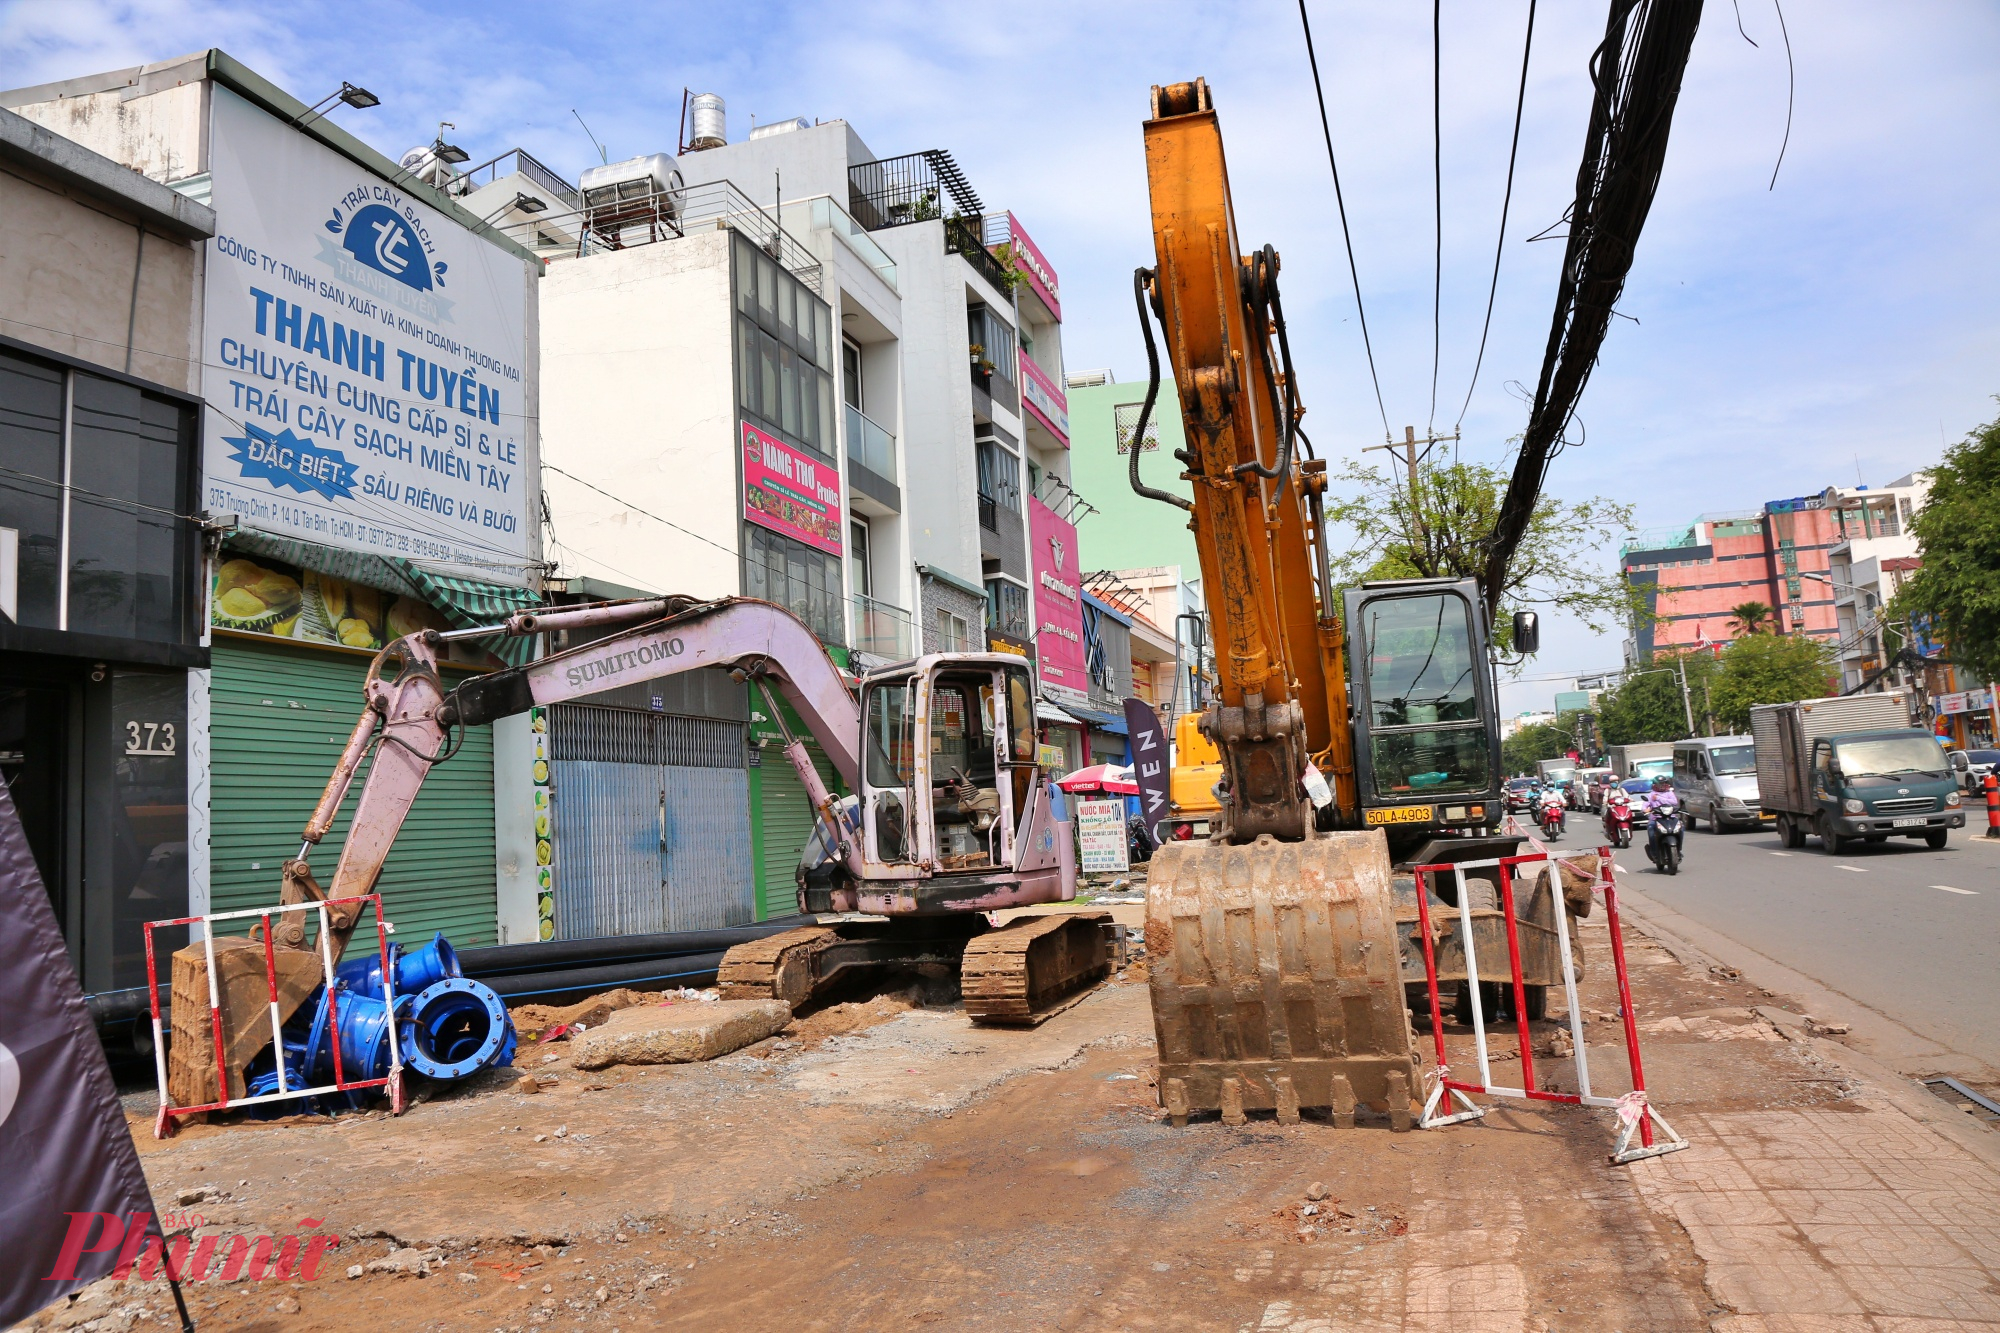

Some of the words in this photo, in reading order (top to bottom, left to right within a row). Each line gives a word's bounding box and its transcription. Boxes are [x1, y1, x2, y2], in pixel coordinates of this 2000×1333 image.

[341, 184, 370, 211] TRÁI
[374, 186, 401, 207] CÂY
[404, 206, 435, 254] SẠCH
[337, 258, 388, 295] THANH
[217, 235, 257, 266] CÔNG
[261, 254, 277, 274] TY
[281, 263, 316, 293] TNHH
[320, 281, 344, 305] SẢN
[348, 293, 377, 319] XUẤT
[380, 309, 394, 328] VÀ
[398, 317, 423, 340] KINH
[426, 330, 461, 357] DOANH
[503, 364, 520, 383] MẠI
[250, 286, 384, 382] THANH
[397, 348, 500, 426] TUYỀN
[220, 337, 327, 399] CHUYÊN
[337, 381, 400, 424] CUNG
[408, 408, 447, 438] CẤP
[455, 421, 471, 449] SỈ
[478, 433, 491, 457] &
[497, 437, 516, 465] LẺ
[229, 379, 287, 423] TRÁI
[297, 404, 345, 441] CÂY
[353, 423, 412, 463] SẠCH
[421, 445, 470, 482] MIỀN
[477, 463, 510, 493] TÂY
[248, 437, 294, 470] ĐẶC
[299, 452, 345, 485] BIỆT:
[362, 470, 399, 501] SẦU
[404, 485, 454, 517] RIÊNG
[459, 500, 478, 523] VÀ
[483, 509, 516, 534] BƯỞI
[762, 441, 793, 479] NÀNG
[794, 457, 815, 491] THƠ
[209, 487, 225, 508] 375
[302, 510, 313, 529] Tân
[566, 637, 685, 687] SUMITOMO
[126, 721, 176, 752] 373
[1099, 803, 1111, 814] MÍA
[1368, 808, 1430, 824] 50LA-4903
